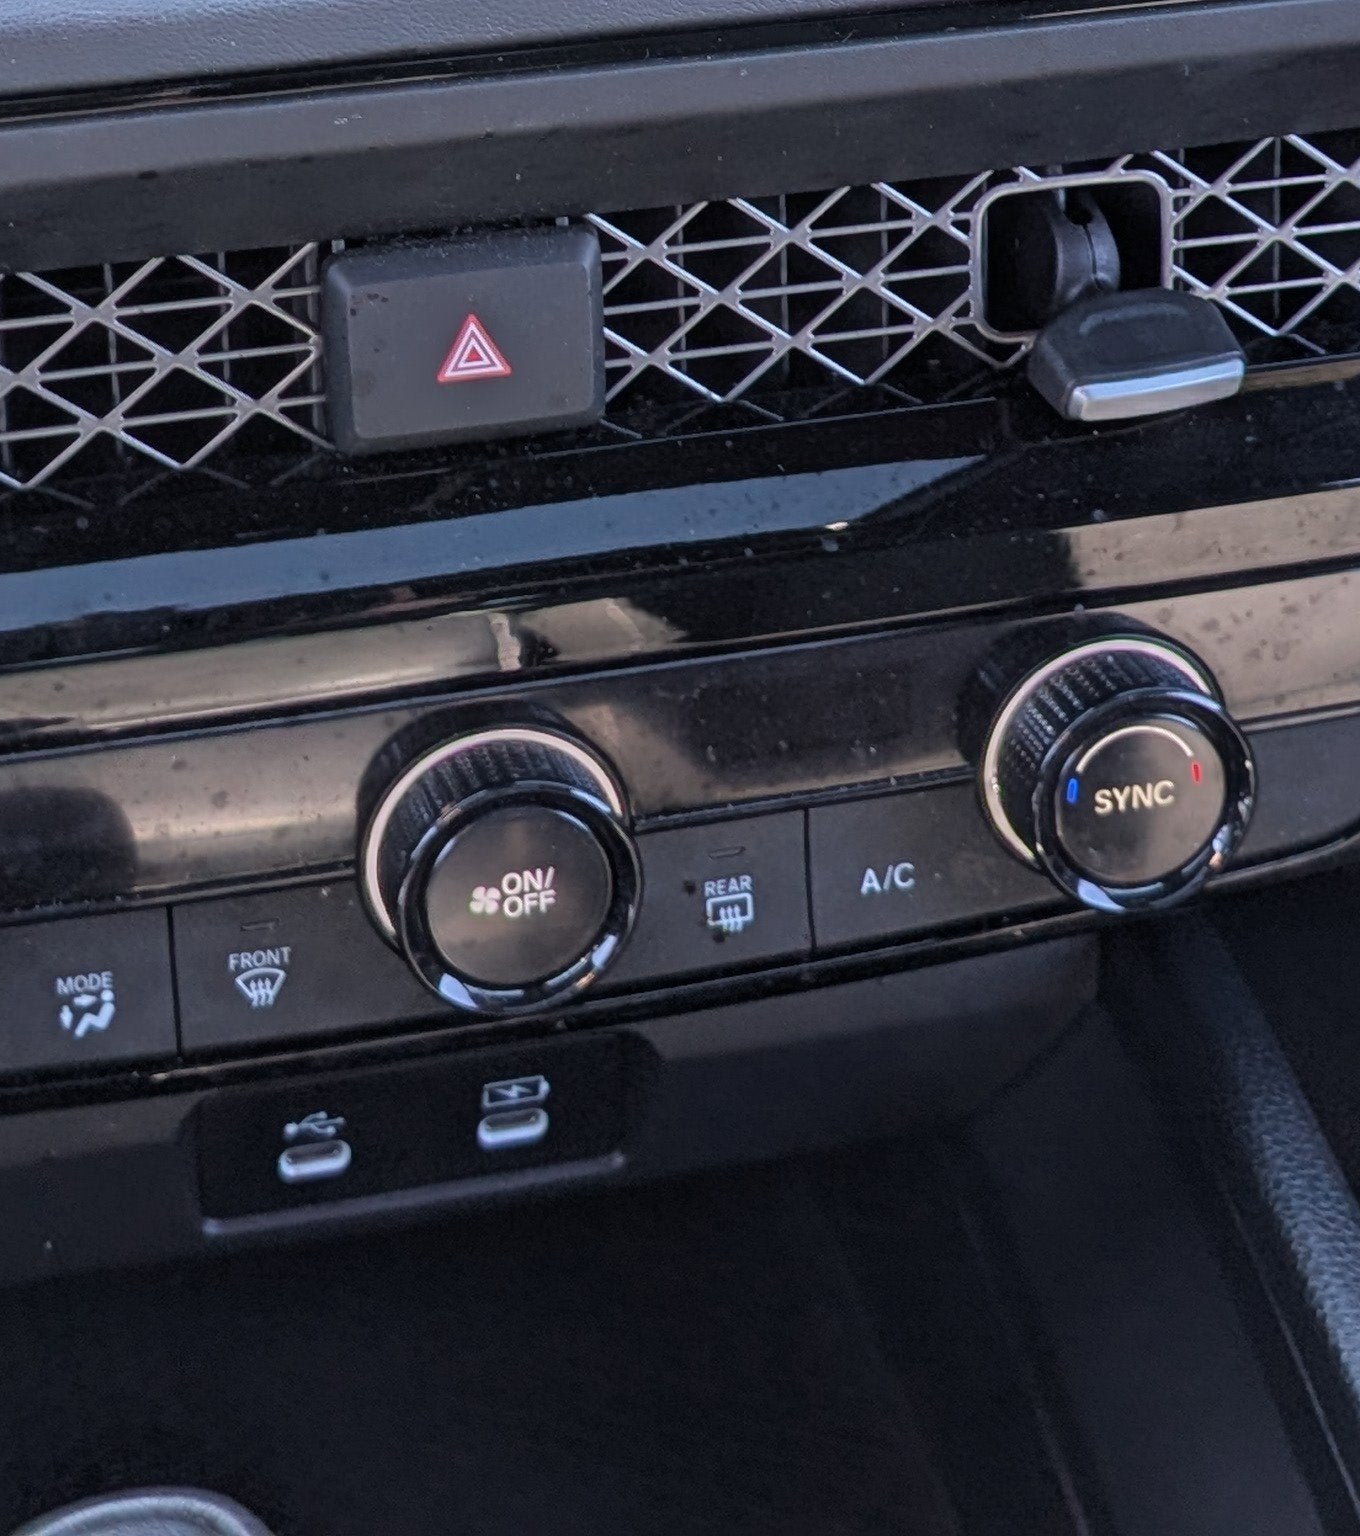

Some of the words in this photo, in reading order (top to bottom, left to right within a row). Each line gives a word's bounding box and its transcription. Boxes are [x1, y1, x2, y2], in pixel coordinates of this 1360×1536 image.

[1093, 778, 1176, 815] SYNC
[500, 868, 555, 894] ON/
[703, 875, 753, 897] REAR
[860, 864, 916, 896] A/C
[502, 889, 556, 919] OFF
[228, 946, 292, 970] FRONT
[56, 972, 114, 993] MODE
